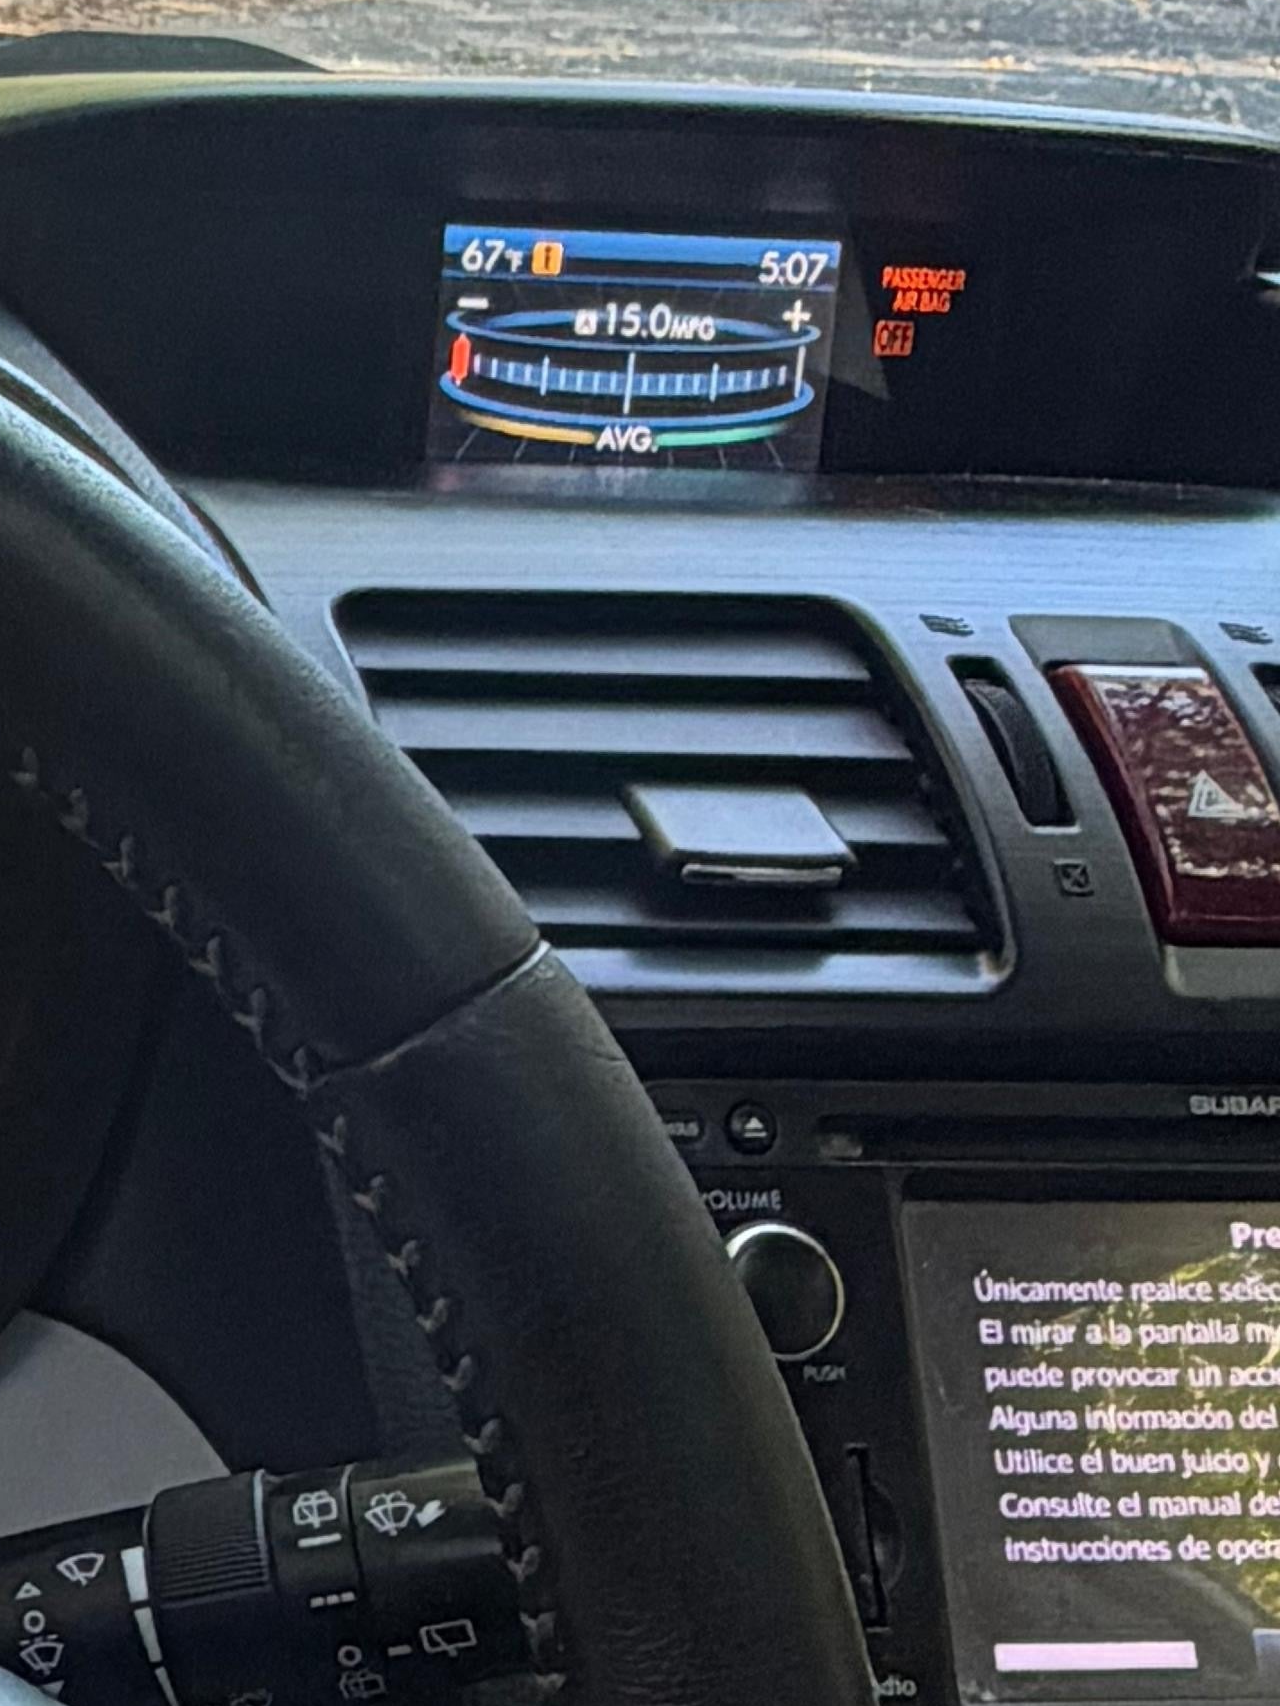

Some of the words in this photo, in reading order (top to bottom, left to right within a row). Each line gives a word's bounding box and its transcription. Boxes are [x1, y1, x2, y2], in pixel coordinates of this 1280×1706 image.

[758, 249, 830, 286] 5:07
[882, 265, 967, 291] PASSENGER
[876, 322, 912, 354] OFF
[595, 426, 658, 454] AVG.
[974, 1268, 1123, 1303] Únicamente
[1131, 1277, 1213, 1303] realice
[979, 1318, 1004, 1345] El
[1011, 1319, 1077, 1345] mirar
[1084, 1324, 1103, 1344] a
[1109, 1319, 1131, 1344] la
[1138, 1318, 1240, 1350] pantalla
[984, 1361, 1064, 1393] puede
[1071, 1366, 1180, 1393] provocar
[1188, 1365, 1222, 1387] un
[988, 1404, 1078, 1437] Alguna
[1084, 1401, 1234, 1433] información
[1239, 1404, 1279, 1431] del
[994, 1448, 1075, 1475] Utilice
[1079, 1447, 1103, 1474] el
[1110, 1448, 1176, 1474] buen
[1181, 1448, 1250, 1479] juicio
[1252, 1452, 1271, 1479] y
[999, 1491, 1112, 1519] Consulte
[1117, 1491, 1142, 1518] el
[1148, 1490, 1242, 1518] manual
[1178, 1533, 1212, 1562] de
